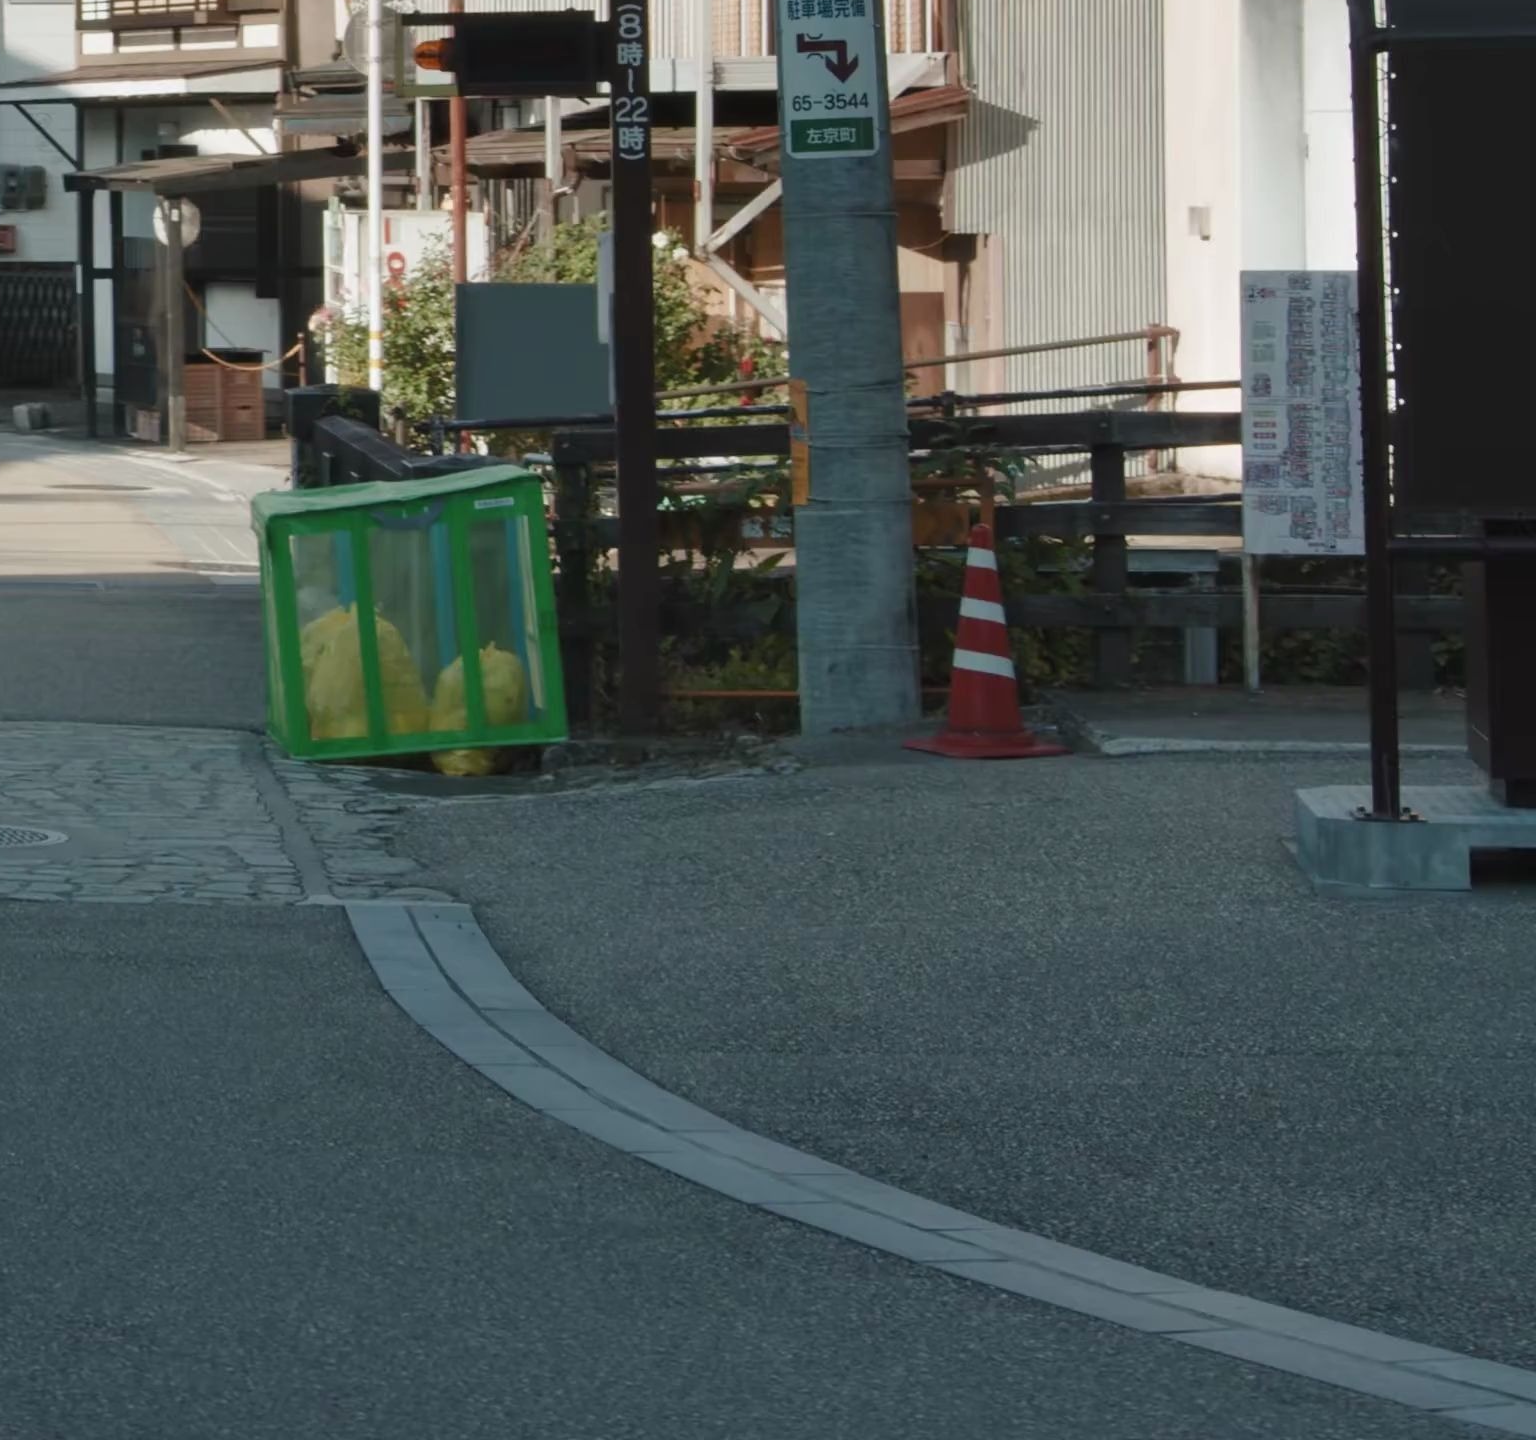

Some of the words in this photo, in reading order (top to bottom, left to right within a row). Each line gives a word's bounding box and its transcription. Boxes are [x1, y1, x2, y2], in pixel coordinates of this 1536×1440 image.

[792, 92, 869, 112] 65-3544
[806, 127, 857, 144] 左京町
